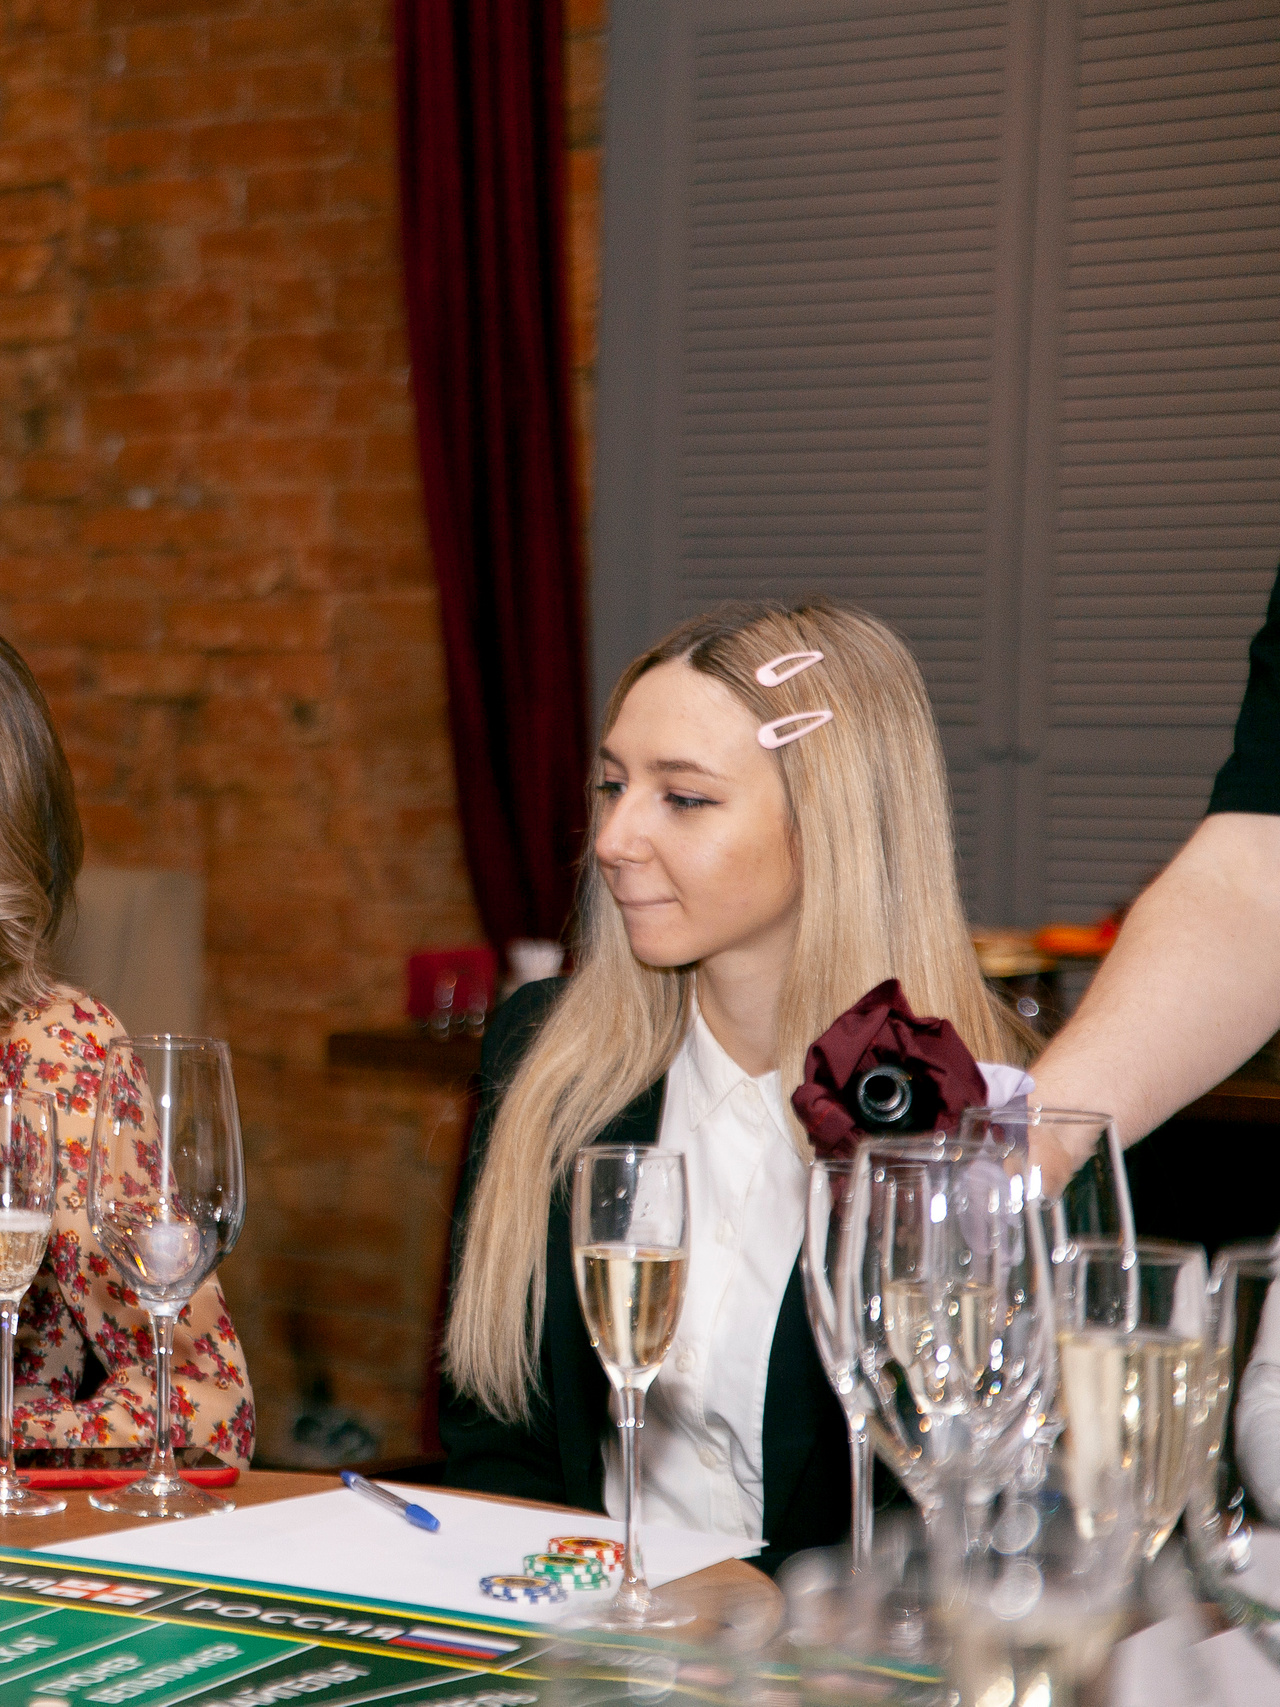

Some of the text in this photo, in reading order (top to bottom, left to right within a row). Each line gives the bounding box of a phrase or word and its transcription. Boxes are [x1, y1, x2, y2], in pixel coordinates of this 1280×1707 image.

[182, 1599, 405, 1641] РОССИЯ
[33, 1653, 144, 1697] ГРЮНЕР
[84, 1642, 244, 1704] ВЕЛЬТЛИНЕР
